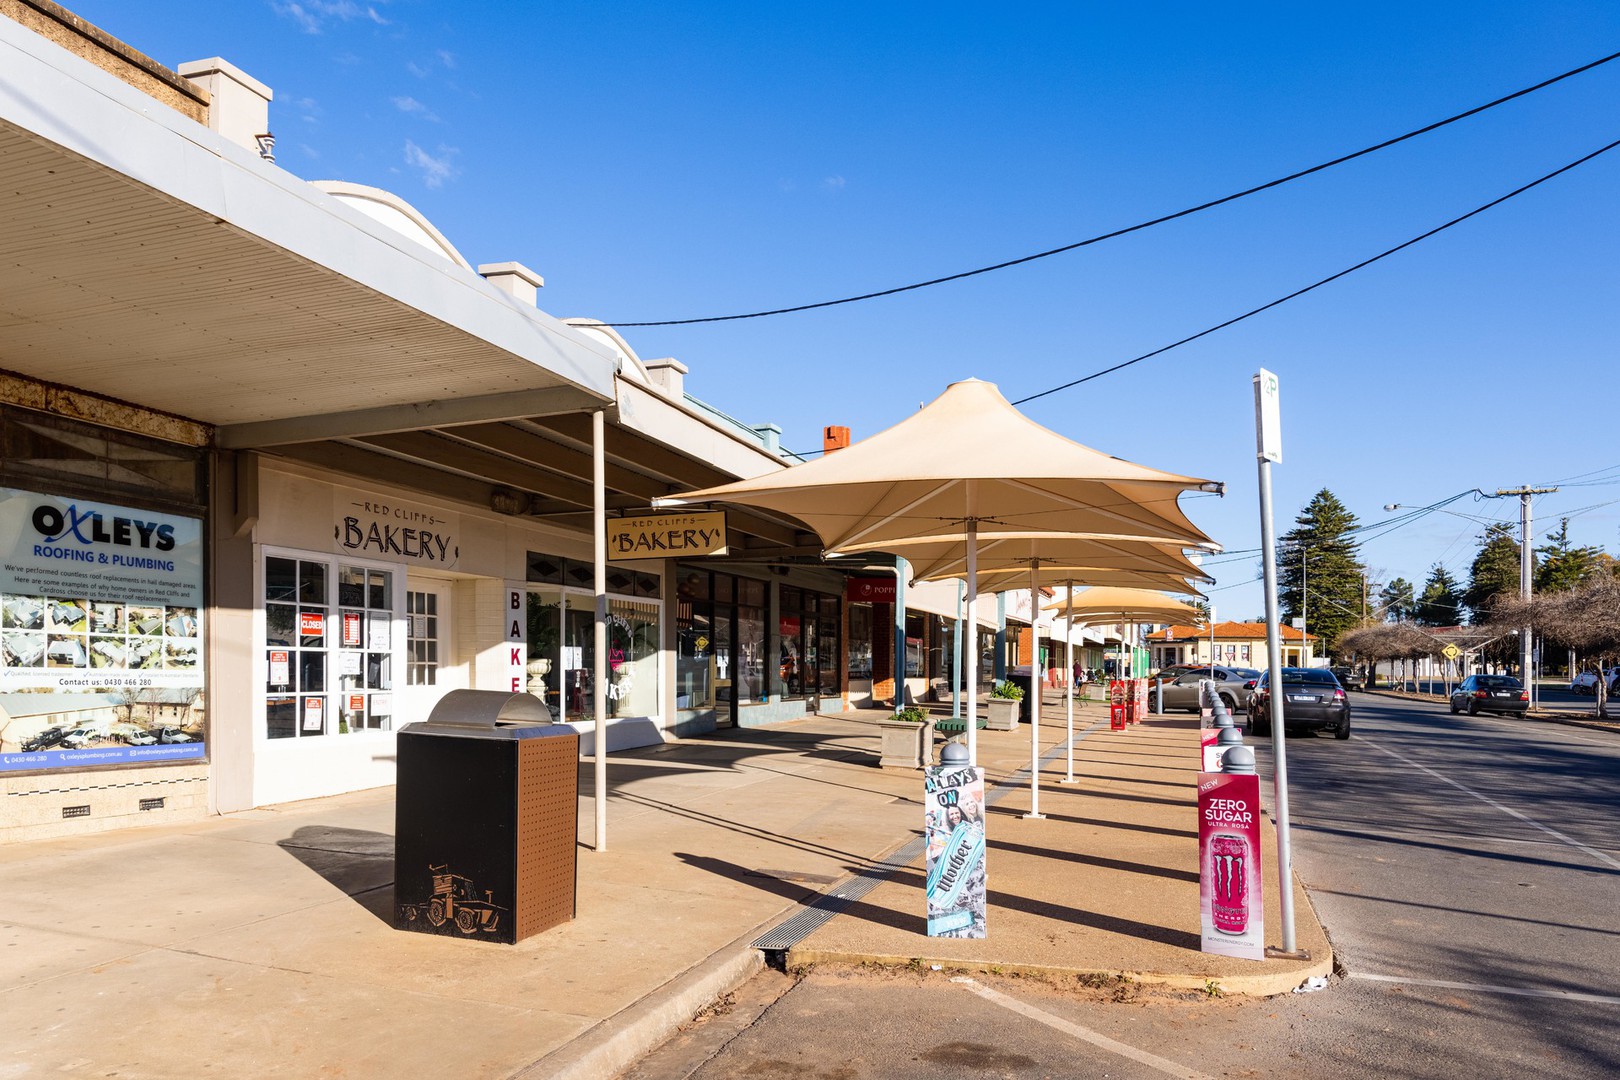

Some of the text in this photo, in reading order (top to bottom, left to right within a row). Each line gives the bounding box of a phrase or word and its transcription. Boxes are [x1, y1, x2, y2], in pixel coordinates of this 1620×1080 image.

[364, 502, 435, 526] RED CLIFFS
[32, 504, 175, 551] OXLEYS
[632, 517, 695, 528] RED CLIFFS
[343, 516, 451, 562] BAKERY
[618, 528, 715, 552] BAKERY
[33, 545, 175, 572] ROOFING & PLUMBING
[4, 564, 24, 572] We've
[25, 566, 59, 575] performed
[60, 570, 88, 579] countless
[103, 575, 140, 584] replacements
[158, 580, 182, 589] damaged
[39, 586, 66, 595] Cardross
[67, 588, 88, 596] choose
[61, 581, 89, 589] examples
[302, 620, 323, 630] CLOSED
[59, 678, 89, 686] Contact
[104, 678, 122, 686] 0430
[124, 678, 137, 686] 466
[926, 769, 973, 793] ALWAYS
[1200, 778, 1219, 792] NEW
[939, 790, 958, 806] ON
[1209, 798, 1247, 811] ZERO
[1205, 809, 1252, 823] SUGAR
